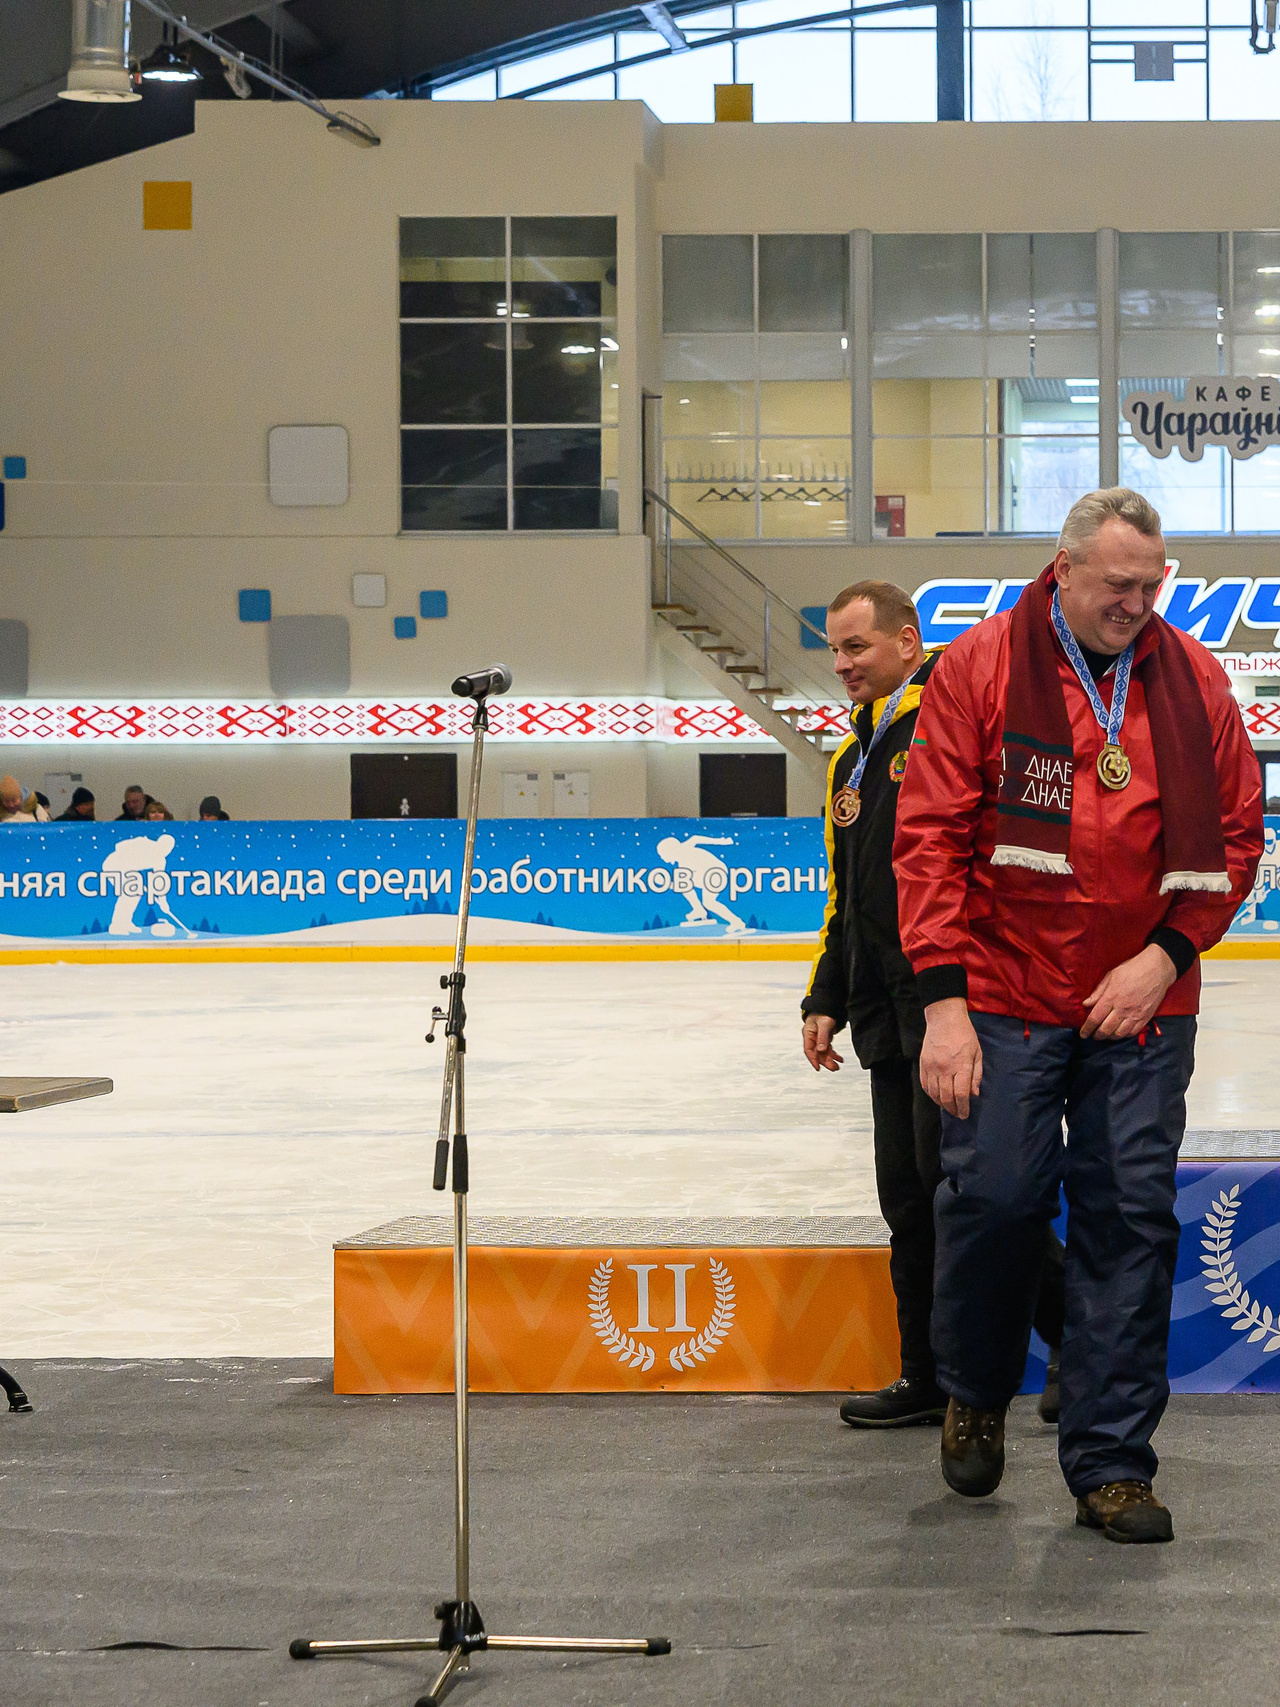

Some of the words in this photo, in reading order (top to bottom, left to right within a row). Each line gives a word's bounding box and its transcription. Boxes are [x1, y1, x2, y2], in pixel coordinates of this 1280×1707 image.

[1196, 386, 1271, 402] КАФЕ
[77, 868, 326, 905] спартакиада
[336, 868, 452, 903] среди
[470, 858, 695, 902] работников
[626, 1264, 697, 1333] II
